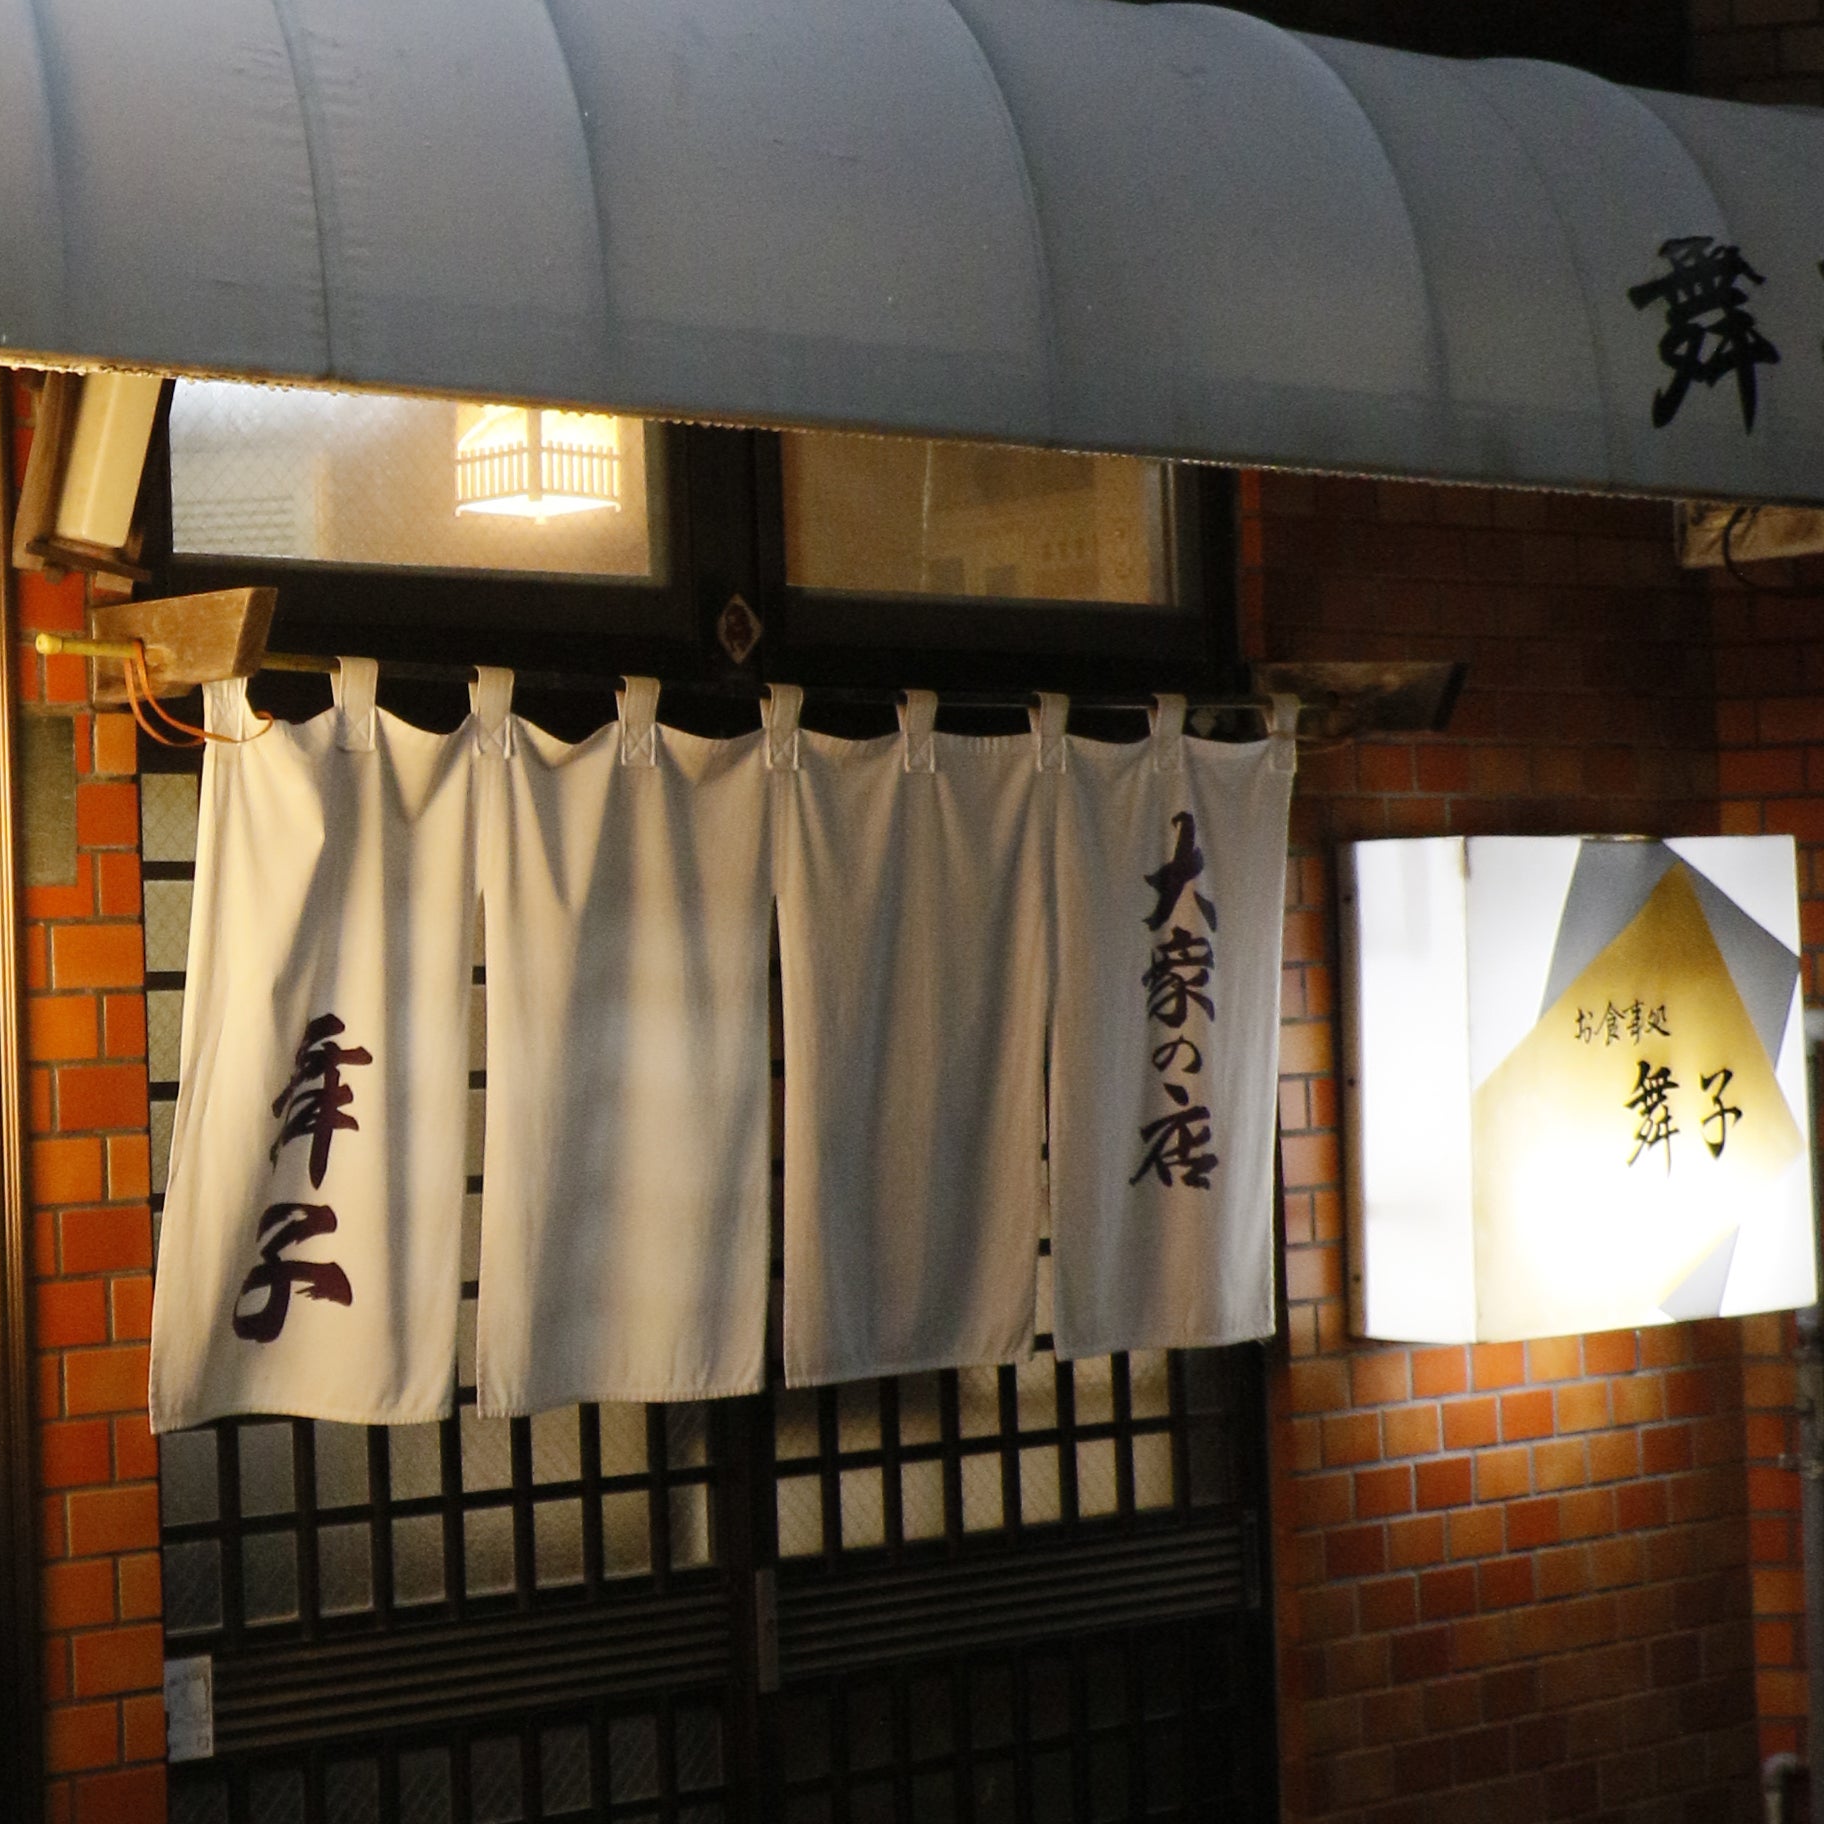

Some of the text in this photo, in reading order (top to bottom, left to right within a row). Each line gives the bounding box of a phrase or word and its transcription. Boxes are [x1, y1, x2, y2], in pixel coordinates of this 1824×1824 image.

[1627, 236, 1824, 434] 舞
[1129, 811, 1219, 1190] 大衆の店
[1573, 998, 1671, 1046] お食事処
[1623, 1059, 1743, 1177] 舞子
